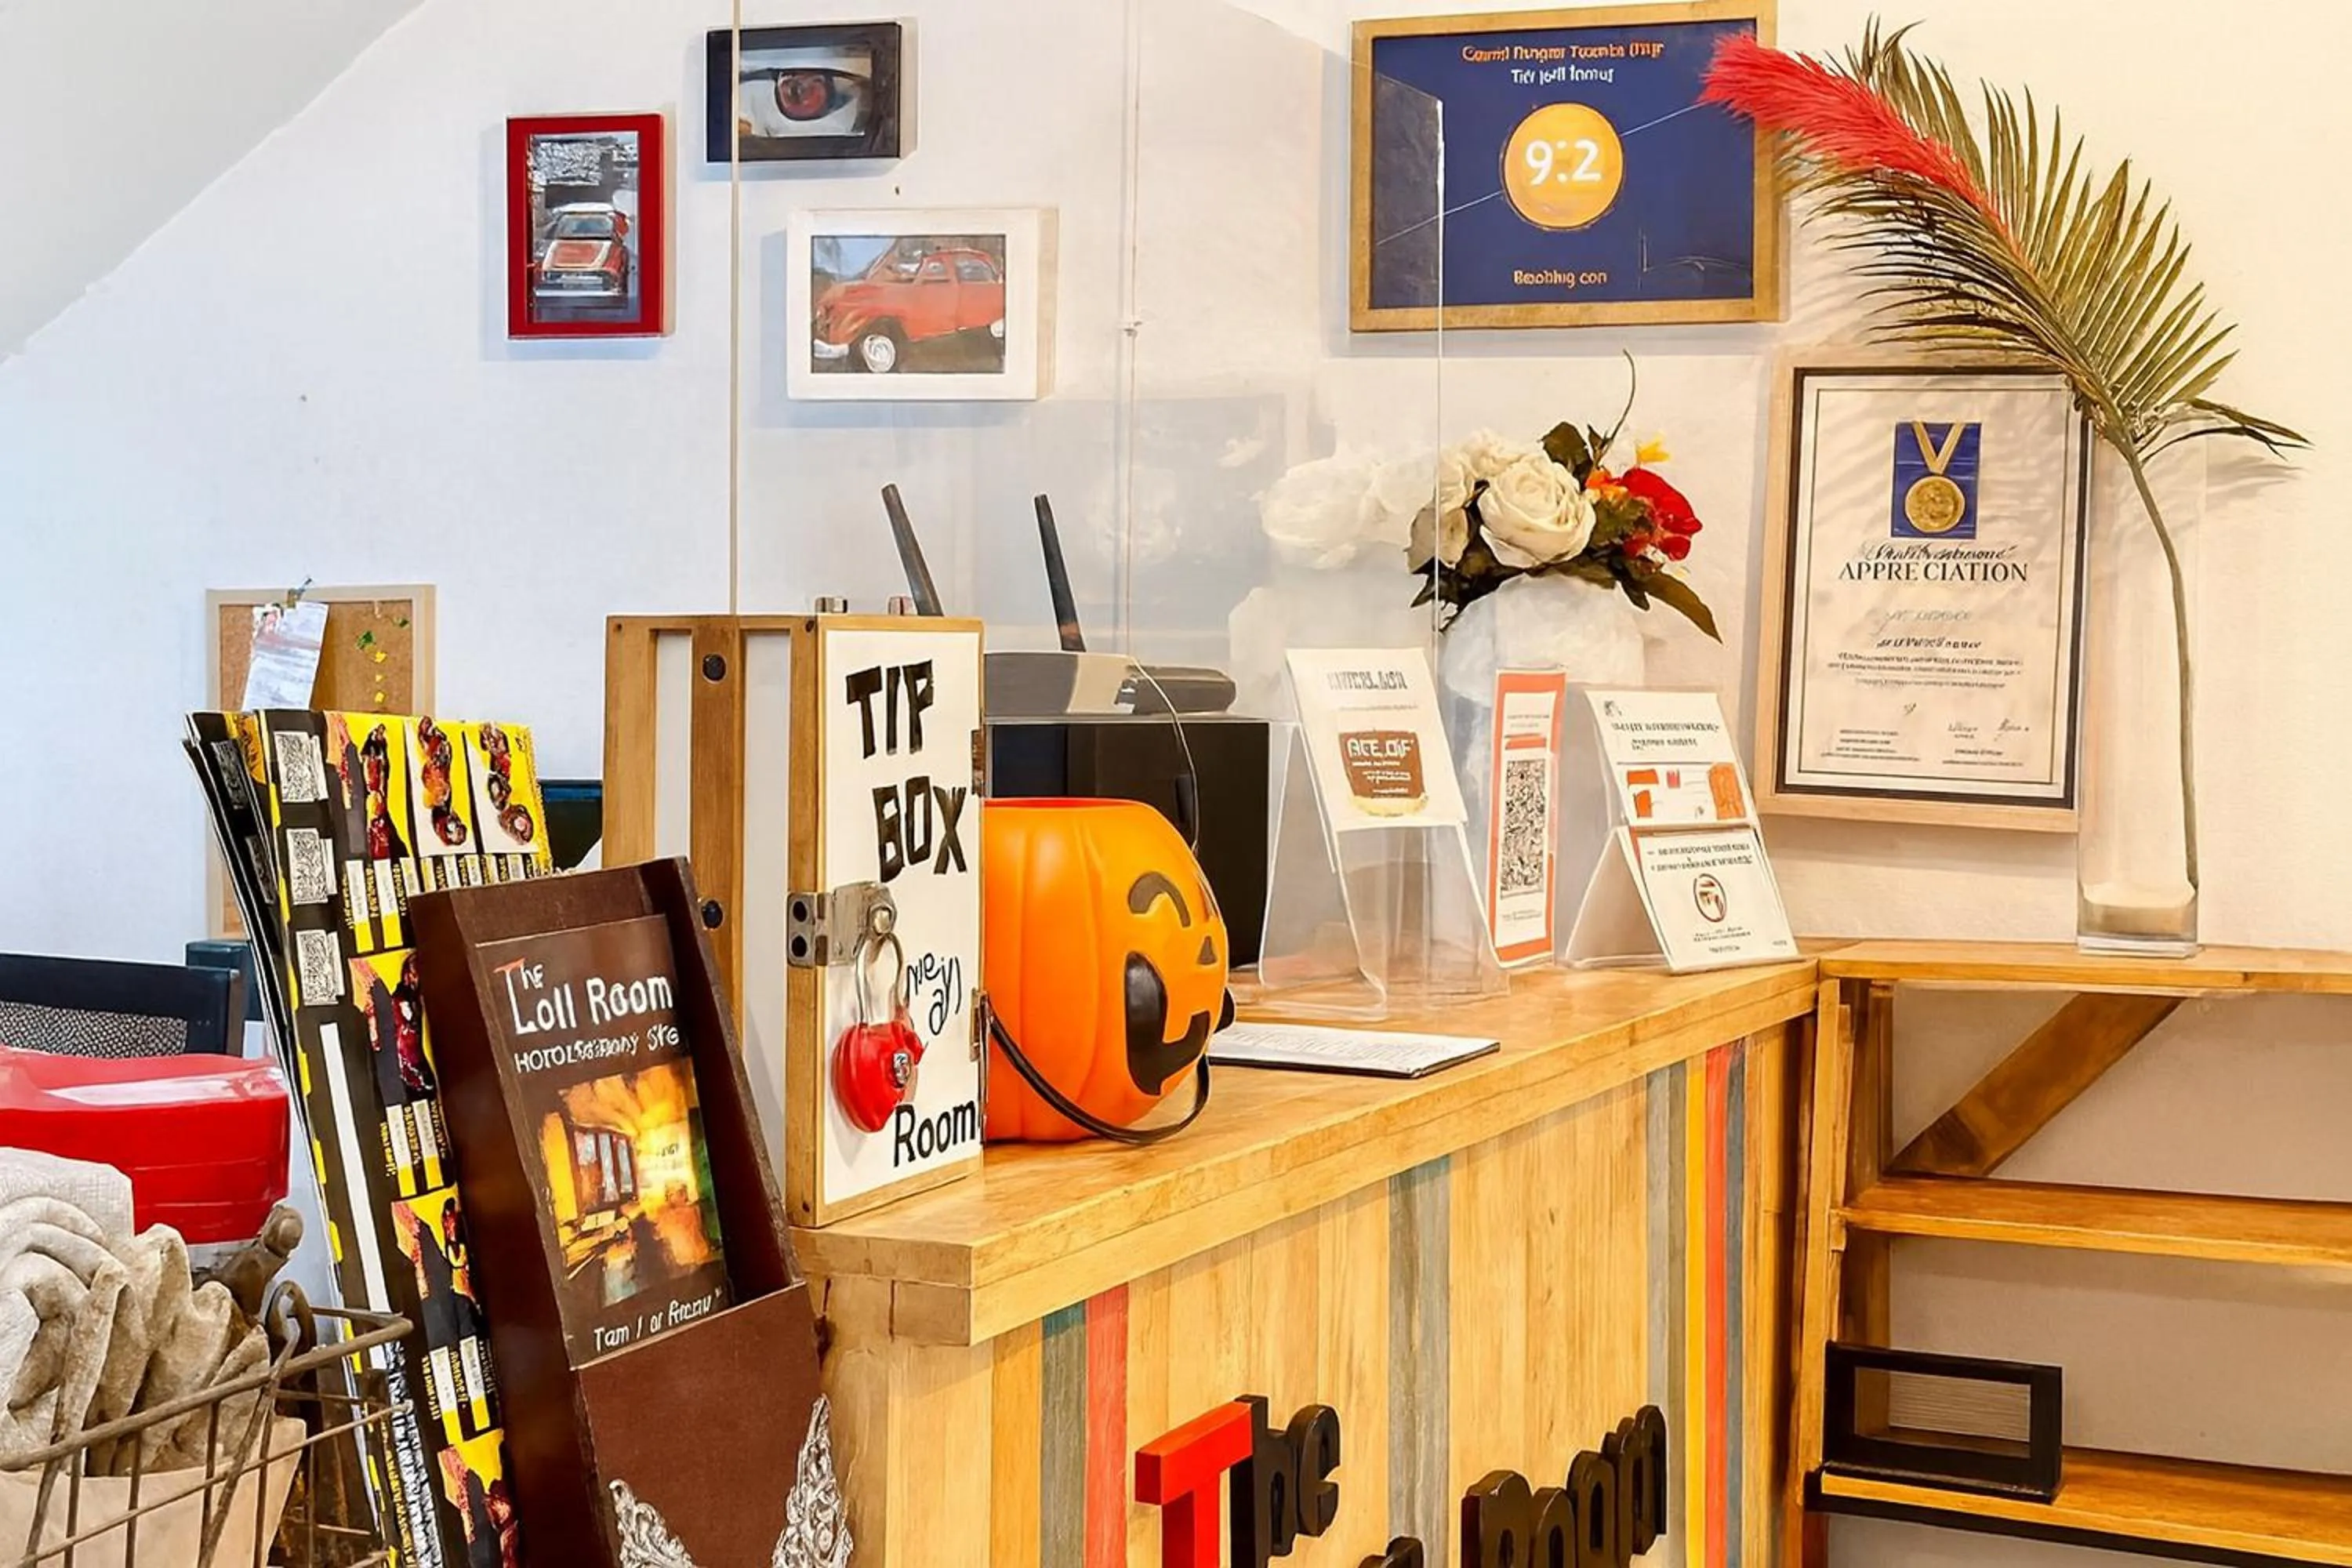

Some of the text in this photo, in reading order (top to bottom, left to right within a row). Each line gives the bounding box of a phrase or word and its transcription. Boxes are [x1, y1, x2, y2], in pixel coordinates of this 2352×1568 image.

[1838, 561, 2029, 583] APPRECIATION
[845, 659, 935, 760] TIP
[872, 775, 967, 884] BOX
[586, 976, 674, 1025] Room
[894, 1099, 977, 1168] Room
[1135, 1394, 1341, 1568] The
